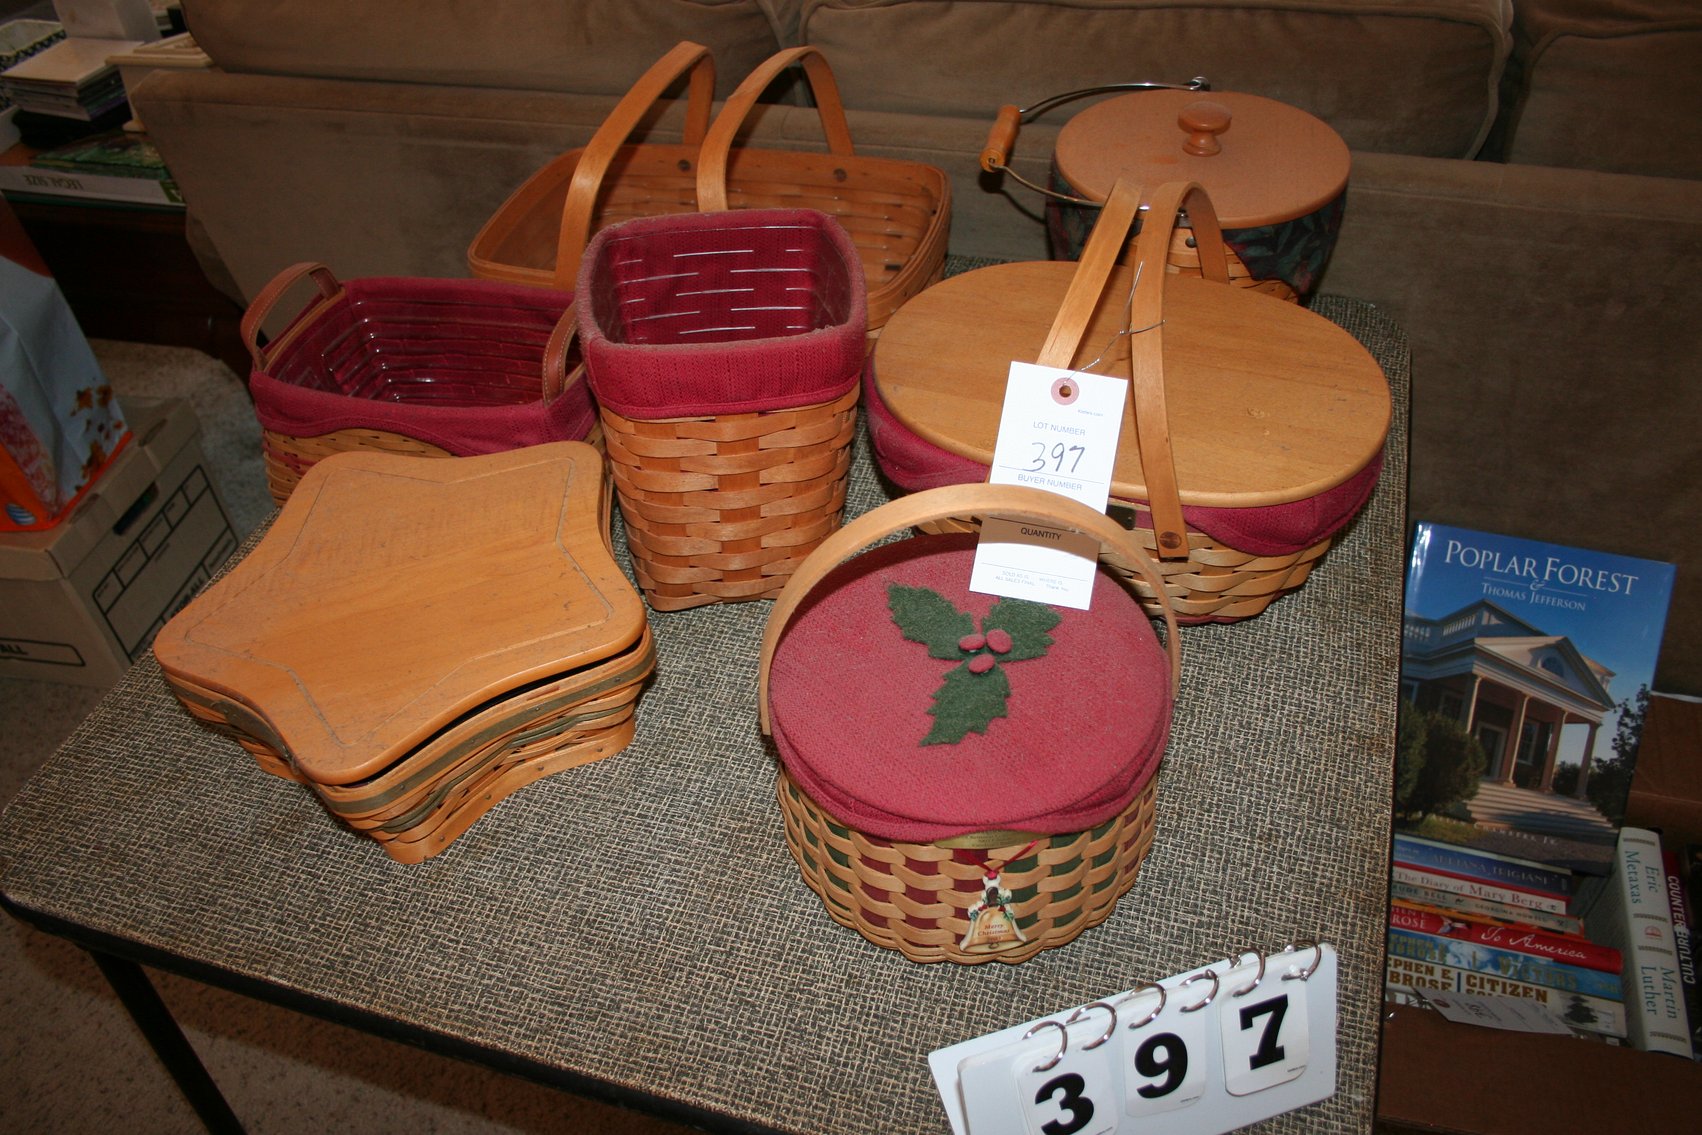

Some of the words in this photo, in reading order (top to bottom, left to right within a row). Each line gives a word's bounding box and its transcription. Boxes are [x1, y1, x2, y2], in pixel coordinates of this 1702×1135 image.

[1033, 421, 1049, 430] LOT
[1050, 425, 1086, 436] NUMBER
[1031, 442, 1085, 473] 397
[1017, 473, 1046, 485] BUYER
[1046, 479, 1083, 491] NUMBER
[1020, 527, 1062, 541] QUANTITY
[1444, 540, 1538, 579] POPLAR
[1543, 557, 1639, 595] FOREST
[1481, 582, 1526, 601] THOMAS
[1529, 591, 1587, 612] JEFFERSON
[1394, 871, 1418, 882] The
[1420, 876, 1449, 891] Diary
[1470, 883, 1505, 903] Mary
[1511, 893, 1543, 911] Berg
[1624, 850, 1642, 905] Metaxas
[1644, 866, 1660, 894] Eric
[1424, 889, 1447, 900] BELL
[1667, 875, 1687, 932] COUNTER
[1480, 926, 1505, 942] To
[1508, 933, 1587, 960] America
[1676, 926, 1696, 985] CULTURE
[1465, 974, 1549, 1004] CITIZEN
[1641, 965, 1658, 1016] Luther
[1660, 966, 1682, 1020] Martin
